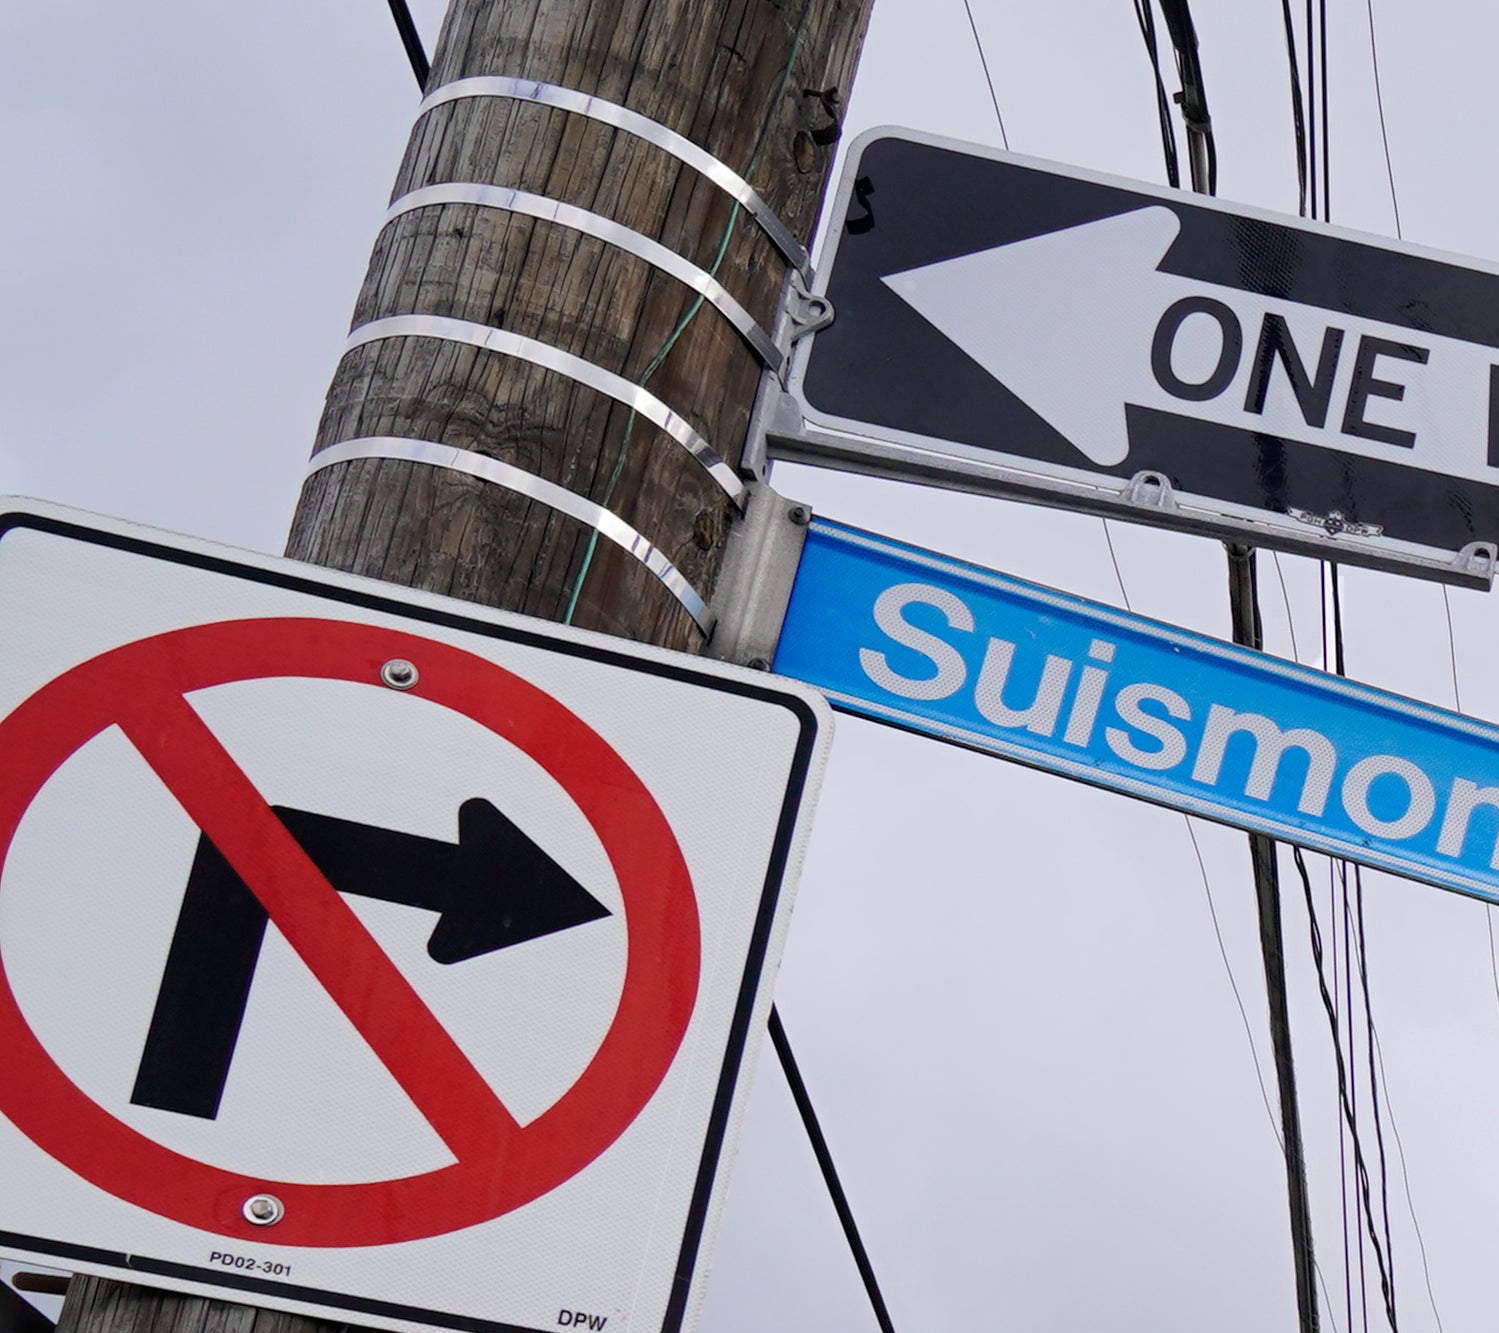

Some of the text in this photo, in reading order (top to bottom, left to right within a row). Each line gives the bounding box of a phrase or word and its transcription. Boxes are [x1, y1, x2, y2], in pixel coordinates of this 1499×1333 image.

[1150, 295, 1431, 450] ONE
[209, 1251, 292, 1278] PD02-301
[557, 1309, 608, 1332] DPW
